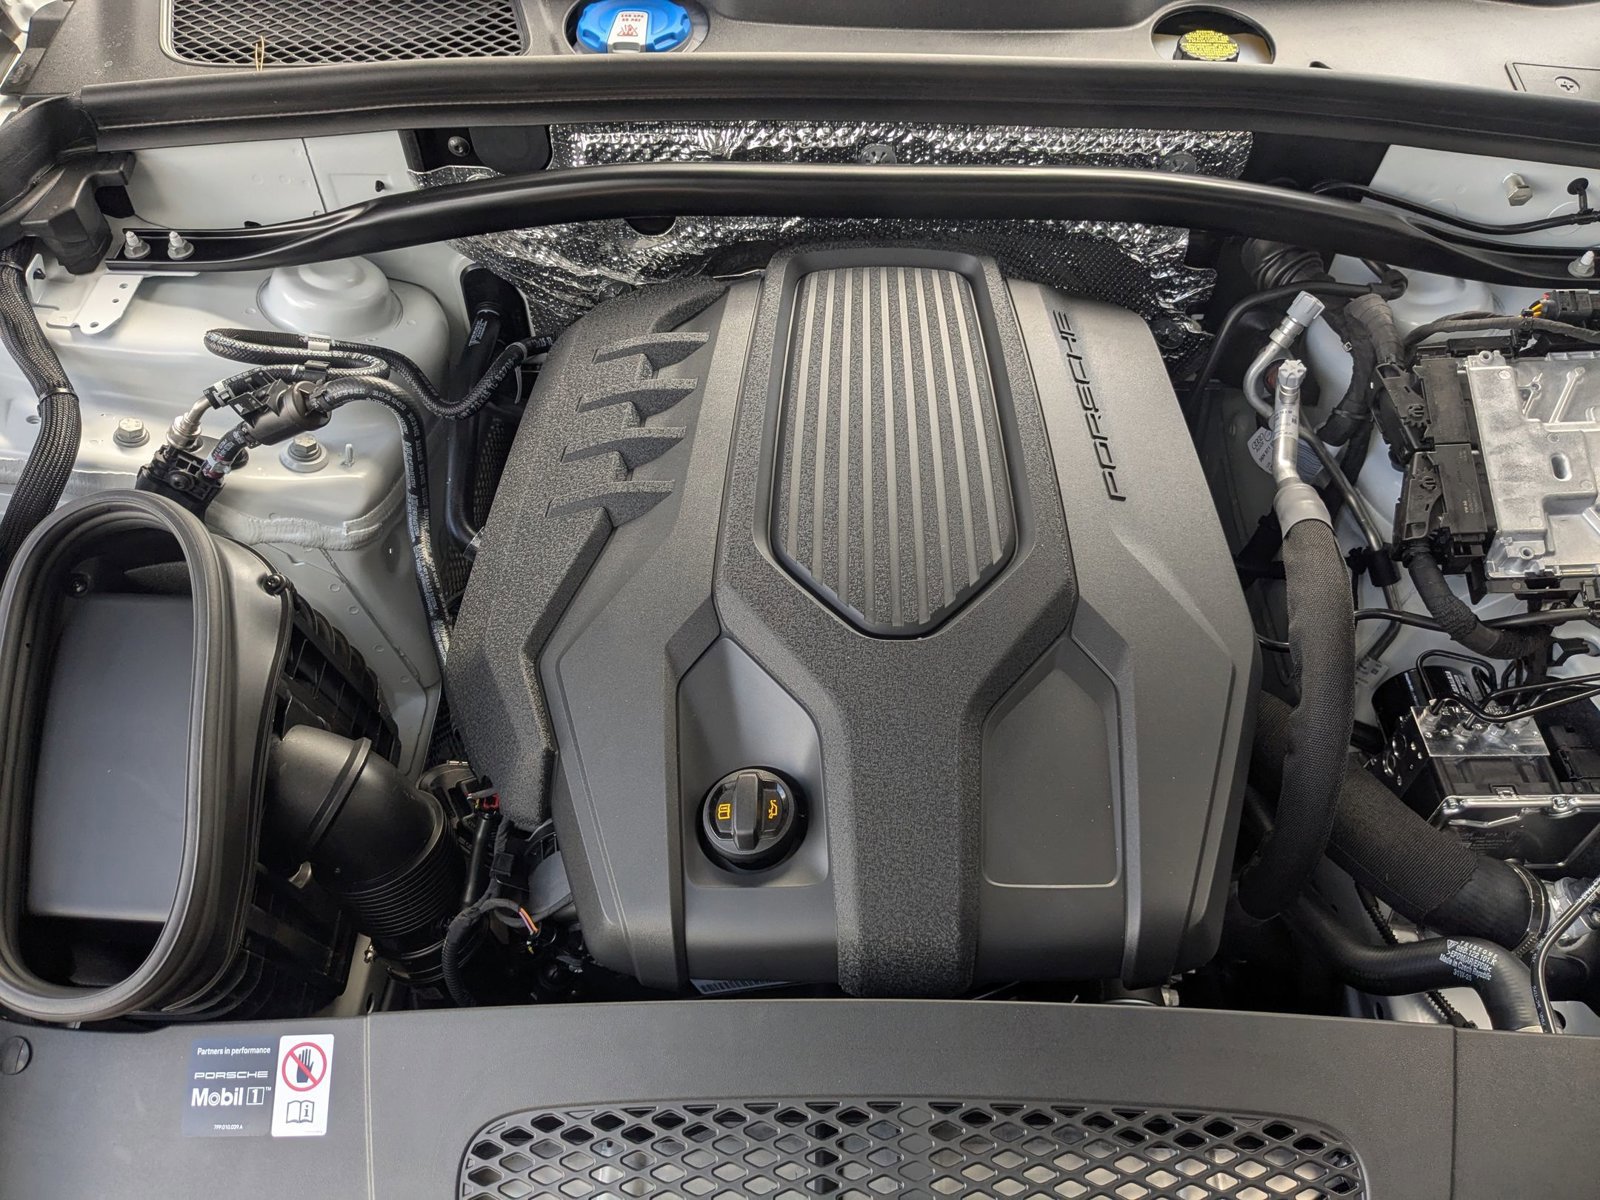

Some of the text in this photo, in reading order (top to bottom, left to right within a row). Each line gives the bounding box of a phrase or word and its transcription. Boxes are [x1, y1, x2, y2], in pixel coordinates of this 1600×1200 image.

[1053, 309, 1126, 502] PORSCHE
[1459, 940, 1498, 959] TRISTONE
[197, 1046, 271, 1057] Partners in performance
[193, 1070, 269, 1080] PORSCHE
[191, 1086, 244, 1107] Mobil
